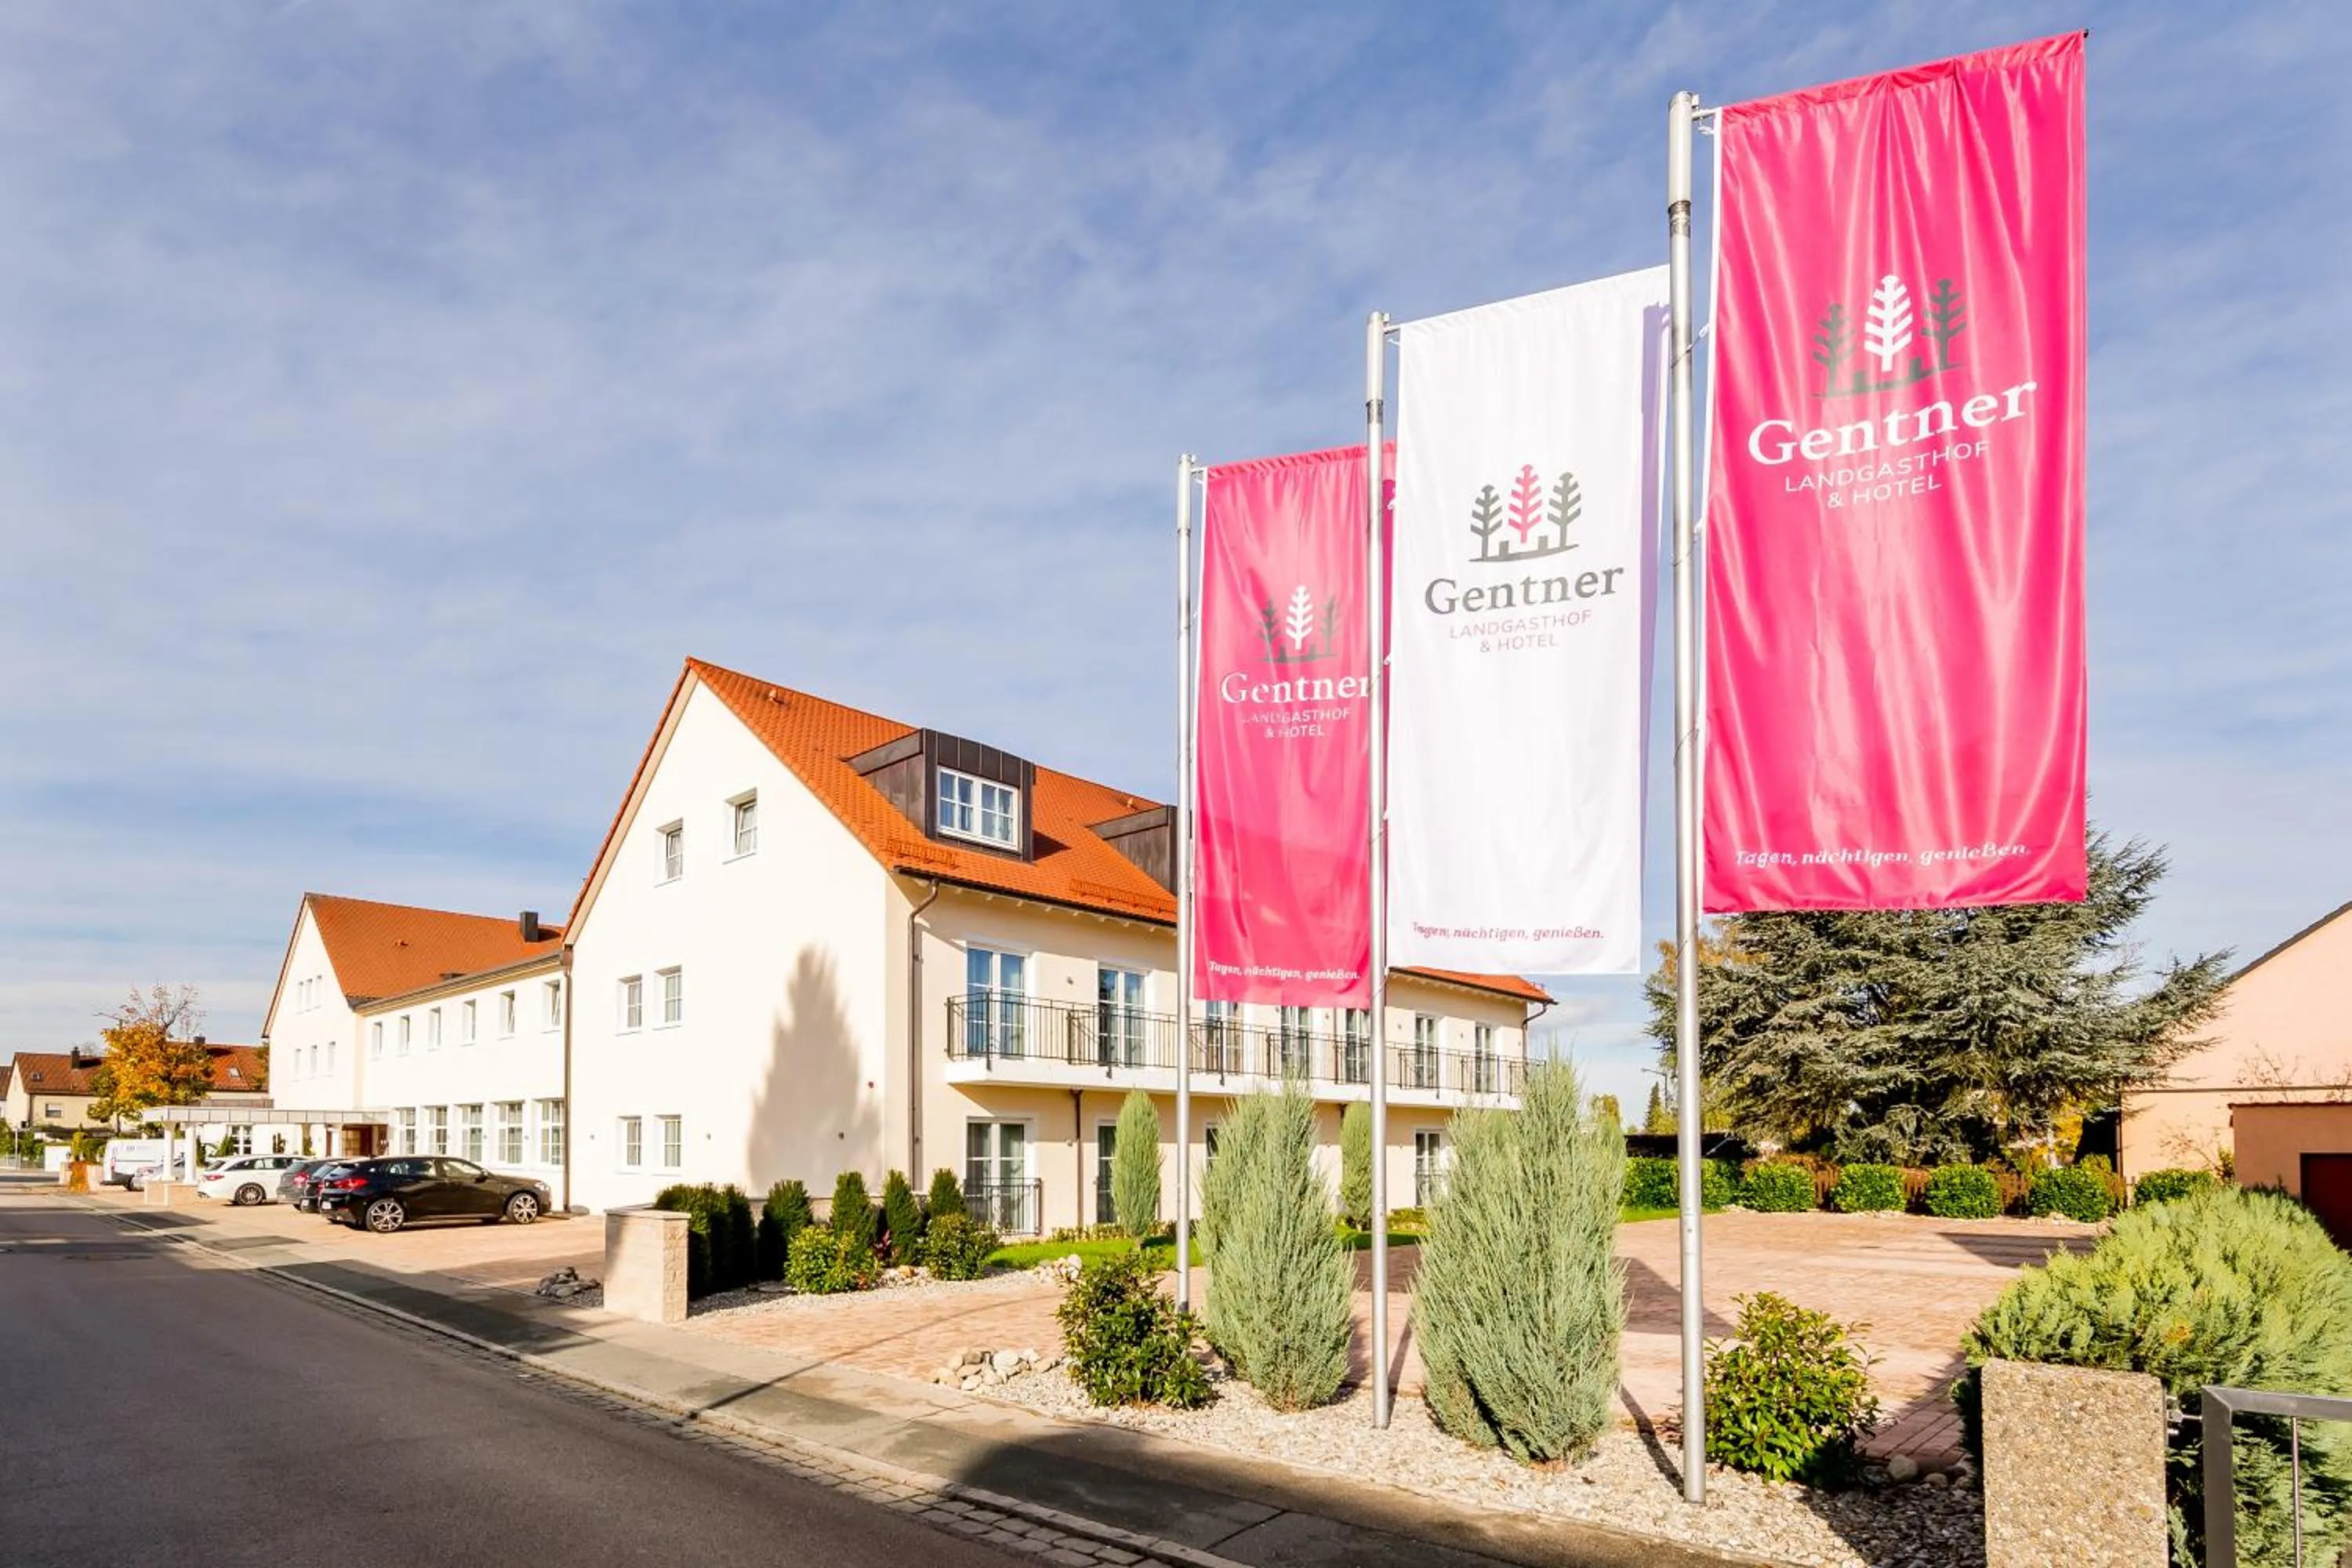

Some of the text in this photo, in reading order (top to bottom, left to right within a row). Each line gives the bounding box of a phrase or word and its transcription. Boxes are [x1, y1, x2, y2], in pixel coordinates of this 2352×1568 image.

[1748, 381, 2038, 465] Gentner
[1784, 440, 1991, 492] LANDGASTHOF
[1828, 474, 1943, 509] & HOTEL
[1425, 567, 1624, 615] Gentner
[1450, 609, 1592, 639] LANDGASTHOF
[1479, 633, 1559, 653] & HOTEL
[1265, 724, 1325, 739] & HOTEL
[1736, 850, 1798, 869] Tagen,
[1533, 926, 1605, 942] genießen.
